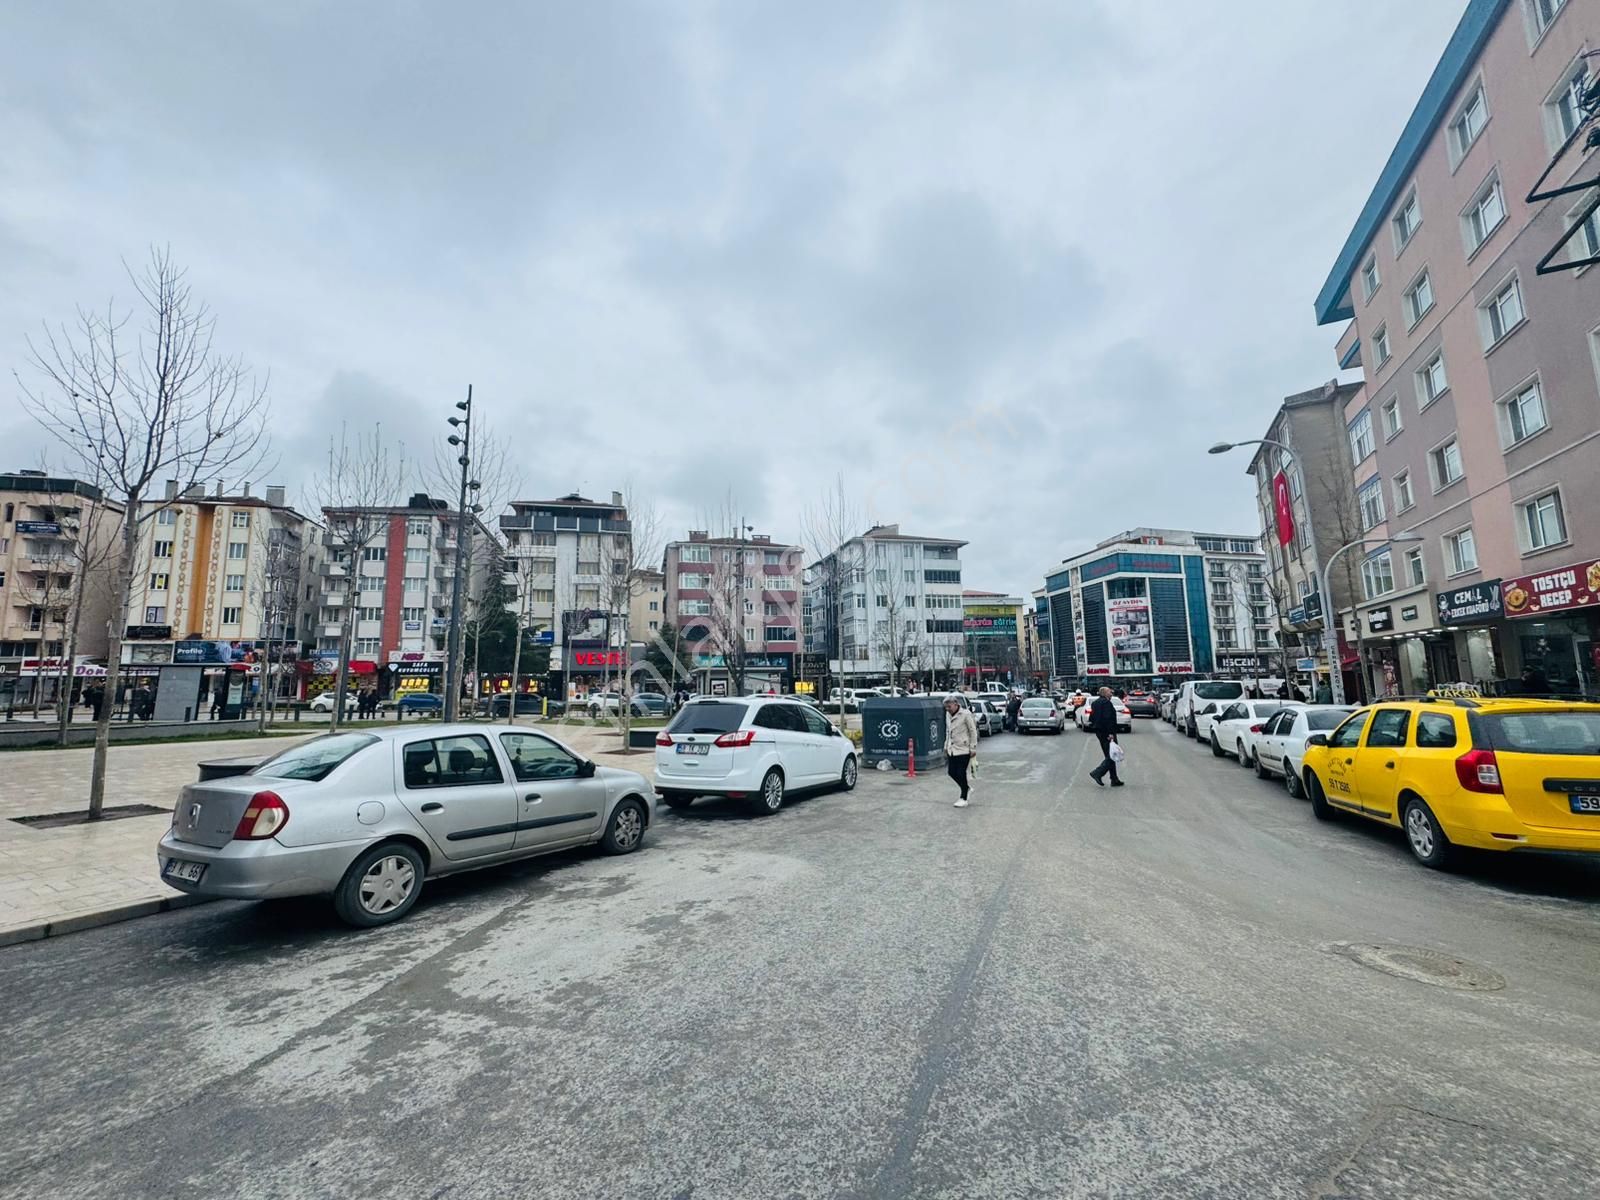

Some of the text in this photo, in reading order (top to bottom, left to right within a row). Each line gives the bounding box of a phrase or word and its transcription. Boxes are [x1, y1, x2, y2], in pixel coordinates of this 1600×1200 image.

[1531, 570, 1577, 592] TOSTÇU
[1540, 590, 1573, 608] RECEP
[575, 652, 631, 666] VESTE
[1580, 797, 1599, 810] 59
